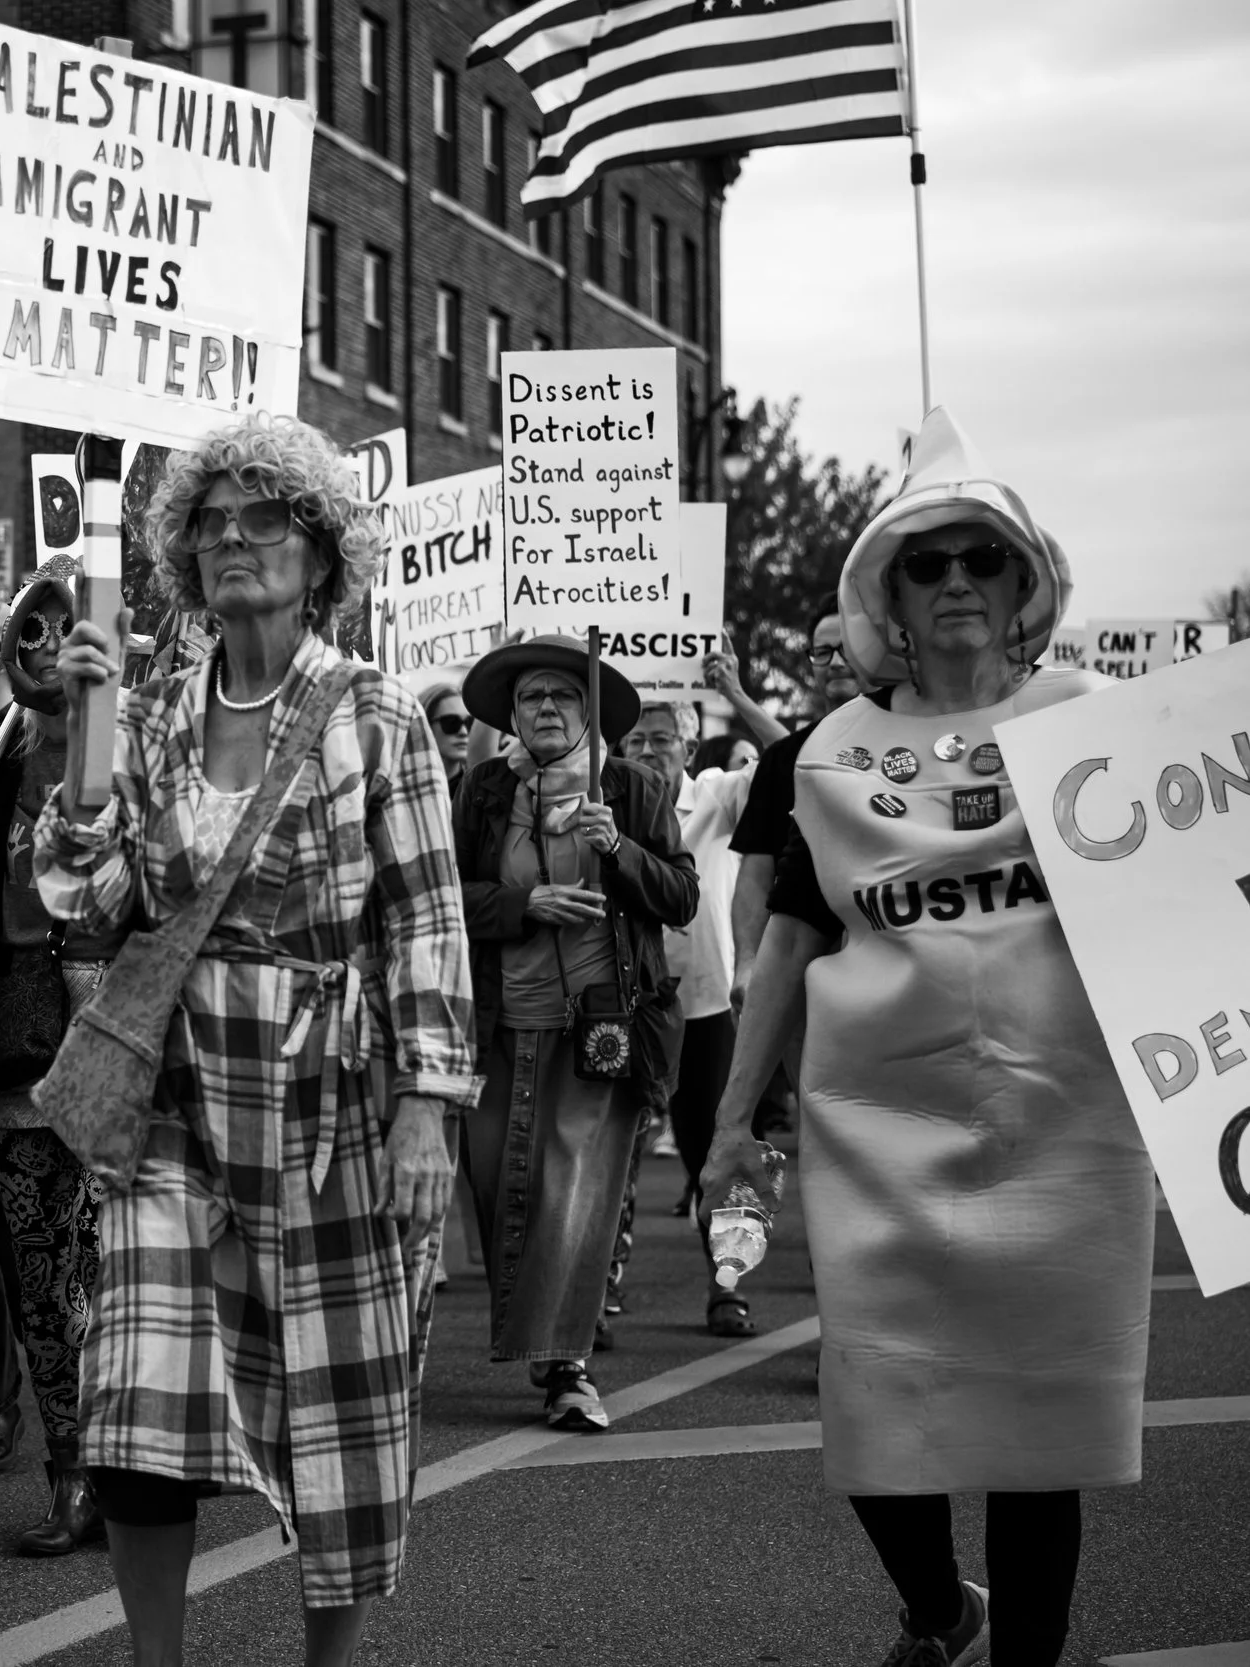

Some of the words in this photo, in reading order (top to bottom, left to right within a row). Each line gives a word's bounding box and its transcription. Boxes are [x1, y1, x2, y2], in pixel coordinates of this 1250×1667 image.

[93, 139, 144, 172] AND
[42, 237, 182, 311] LIVES
[2, 299, 258, 411] MATTER!!
[509, 373, 621, 403] Dissent
[631, 378, 654, 400] is
[510, 411, 655, 444] Patriotic!
[509, 455, 584, 484] Stand
[596, 457, 674, 493] against
[509, 495, 561, 524] U.S.
[570, 497, 662, 534] support
[402, 520, 491, 586] BITCH
[565, 533, 657, 564] Israeli
[513, 573, 669, 606] Atrocities!
[402, 584, 486, 631] THREAT
[402, 621, 503, 671] CONSTIT
[599, 633, 717, 657] FASCIST
[1098, 628, 1157, 654] CAN'T
[883, 750, 913, 763] BLACK
[884, 757, 916, 771] LIVES
[887, 765, 917, 778] MATTER
[956, 794, 979, 806] TAKE
[958, 803, 996, 823] HATE
[853, 861, 1050, 932] MUSTA
[1132, 1010, 1250, 1102] DE
